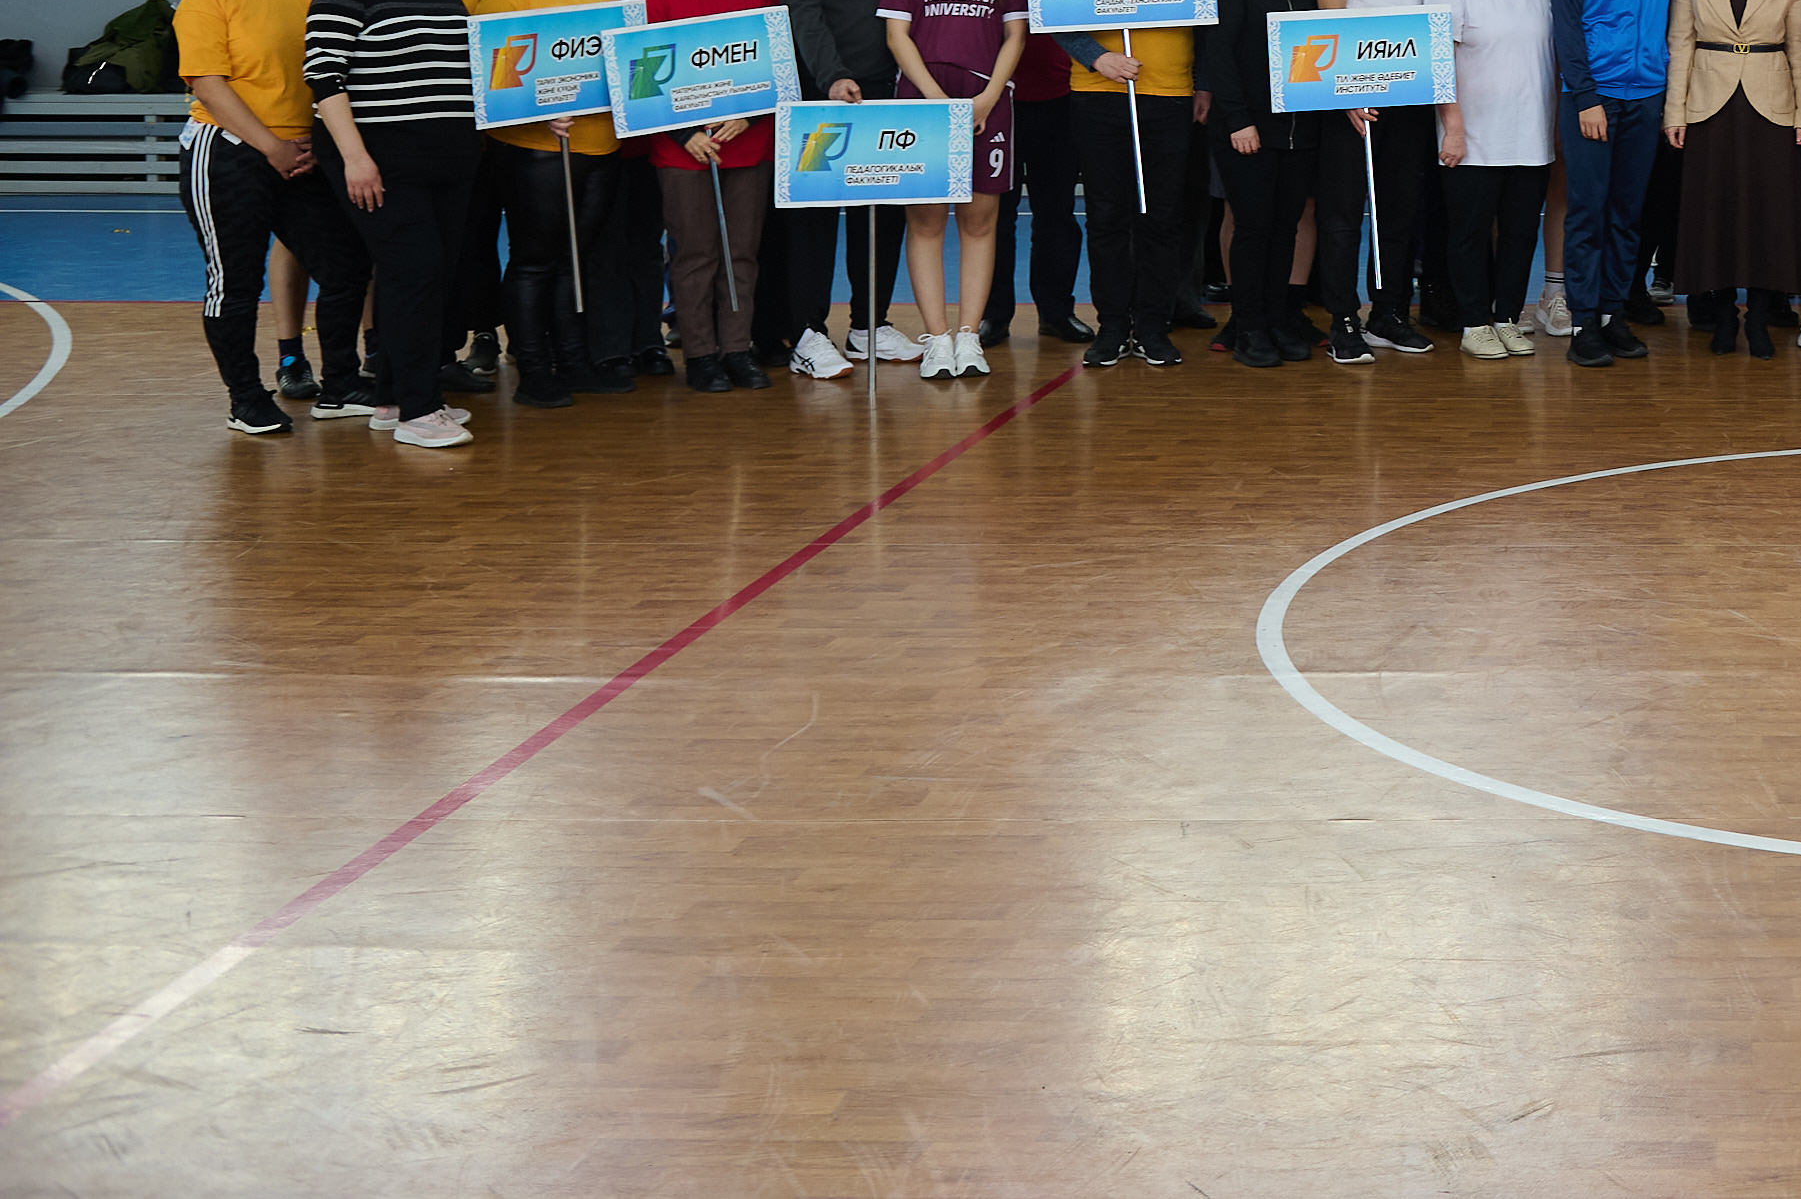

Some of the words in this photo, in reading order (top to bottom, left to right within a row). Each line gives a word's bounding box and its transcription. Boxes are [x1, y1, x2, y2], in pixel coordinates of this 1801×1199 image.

[691, 41, 757, 68] ФМЕН
[1357, 38, 1417, 59] ИЯиЛ
[1336, 75, 1350, 84] ТІЛ
[1351, 74, 1376, 83] ЖӘНЕ
[1377, 71, 1416, 82] ӘДЕБИЕТ
[672, 83, 712, 95] МАТЕМАТИКА
[1335, 83, 1388, 94] ИНСТИТУТЫ
[878, 130, 916, 149] ПФ
[845, 164, 925, 175] ПЕДАГОГИКАЛЫҚ
[988, 148, 1004, 178] 9
[845, 175, 899, 185] ФАКУЛЬТЕТІ
